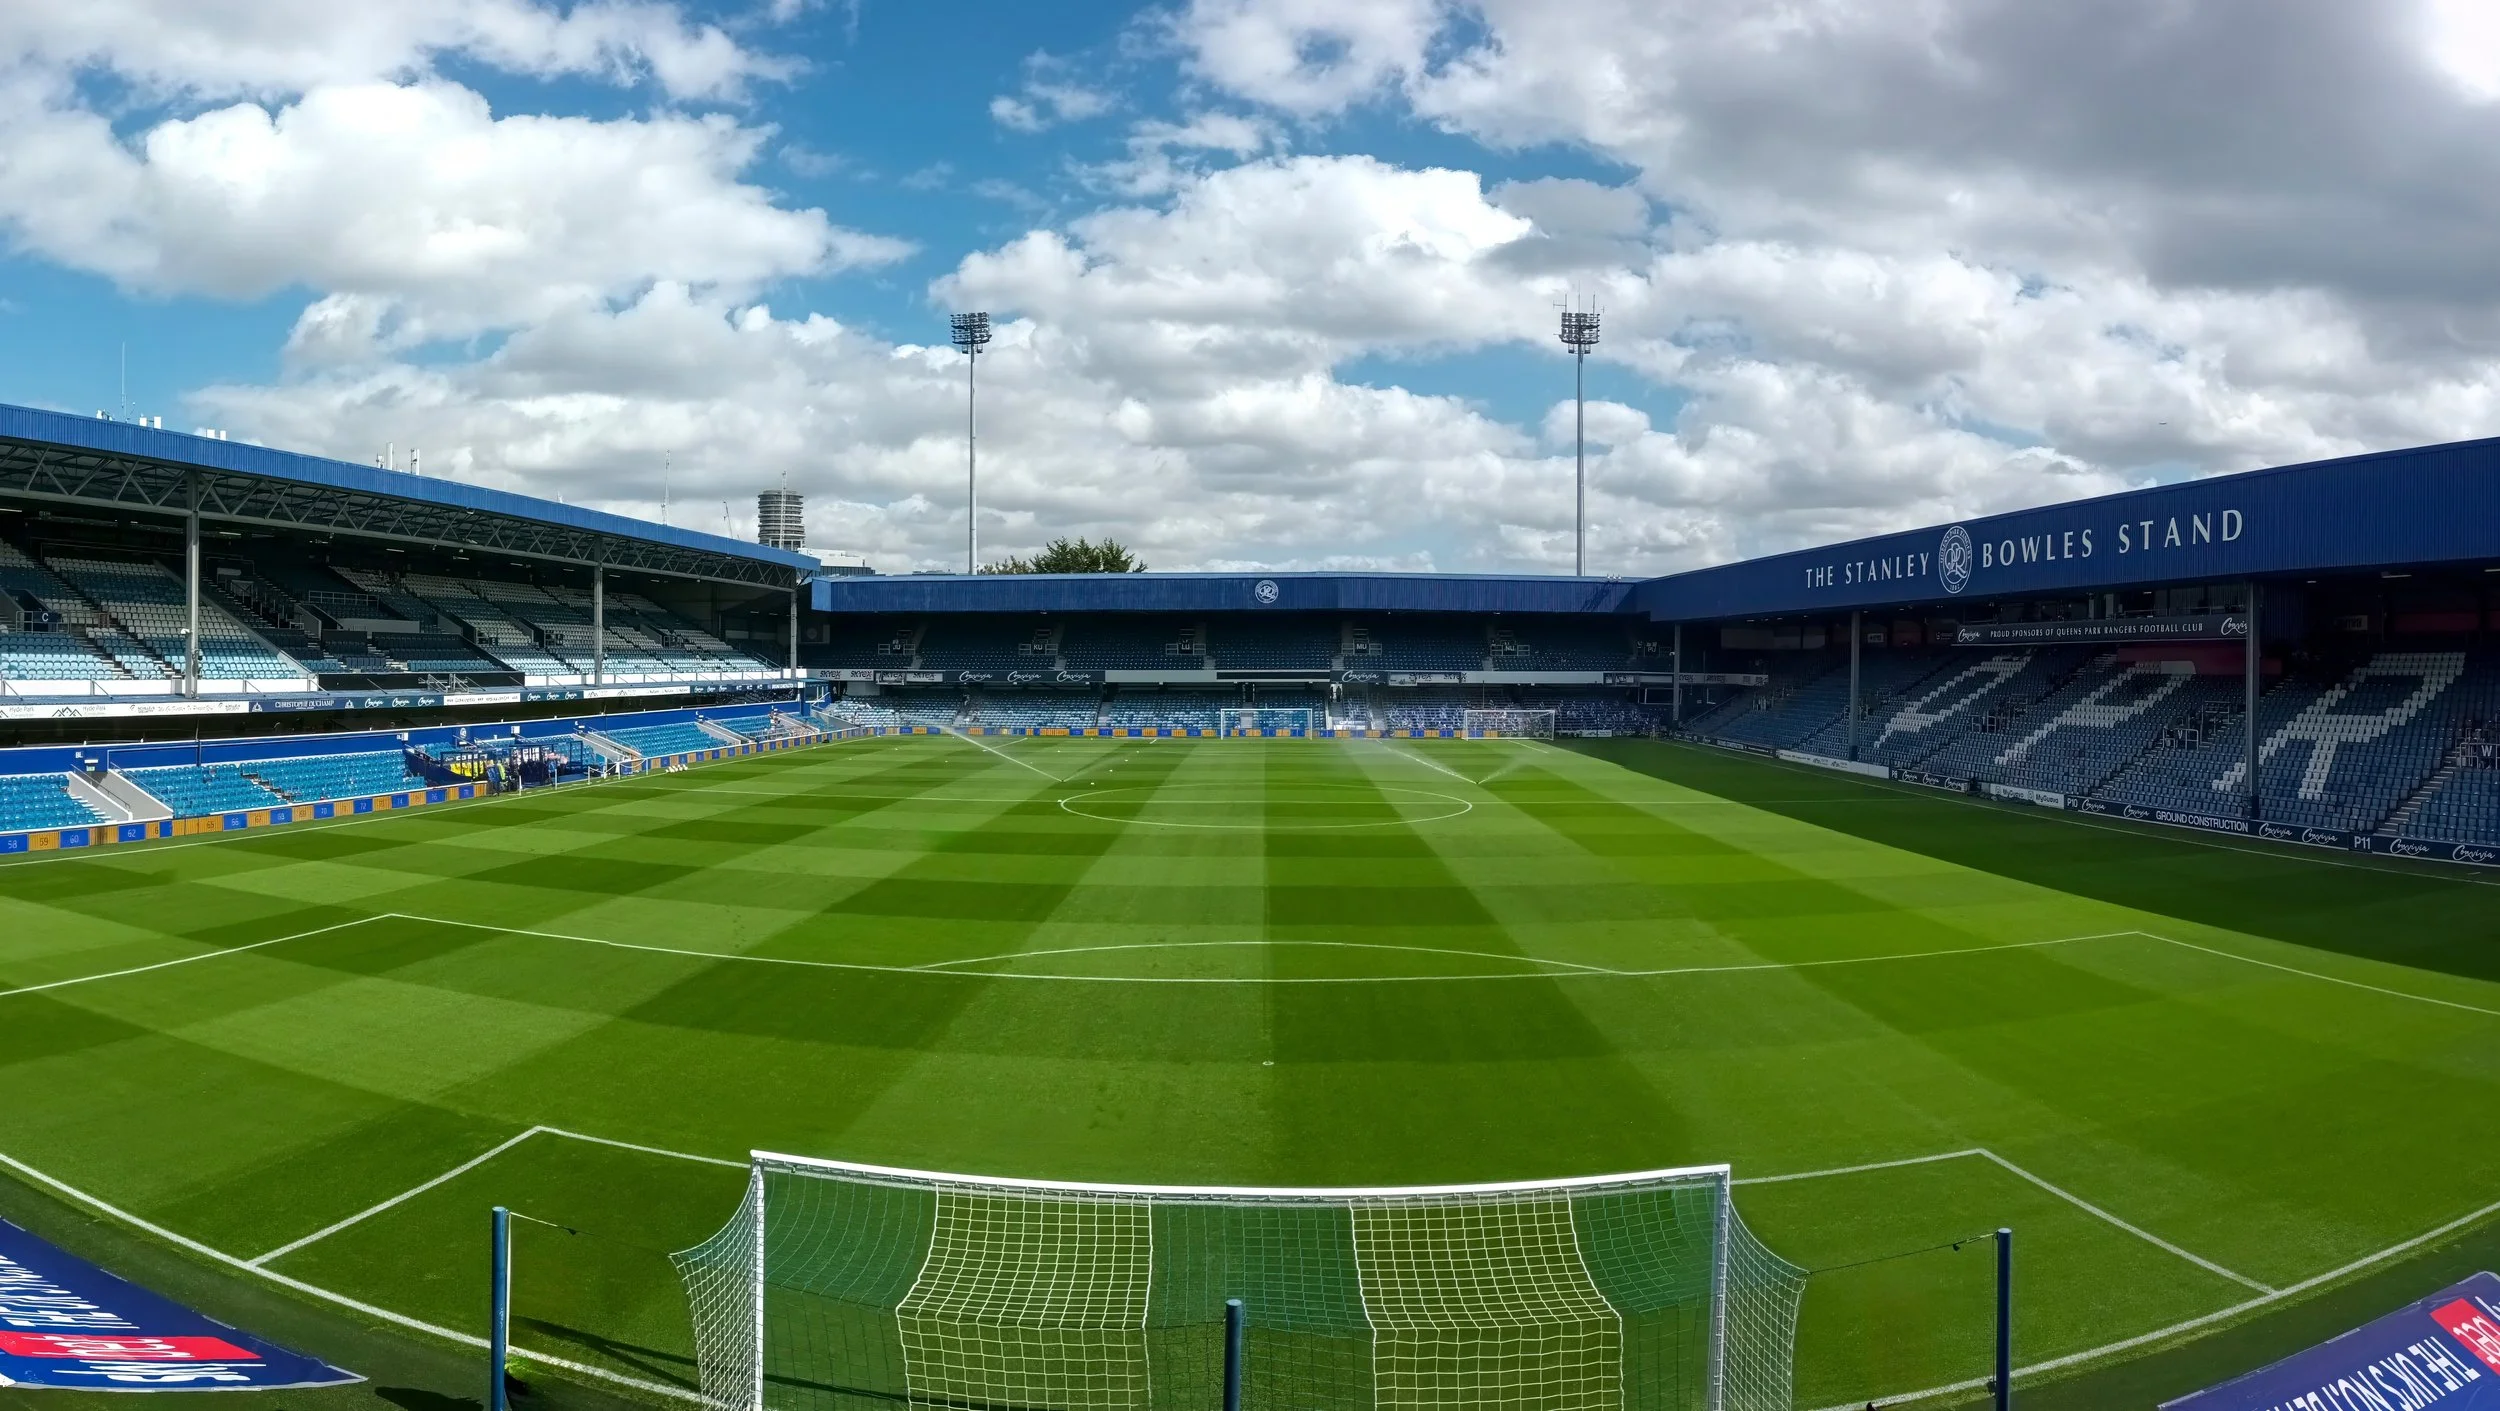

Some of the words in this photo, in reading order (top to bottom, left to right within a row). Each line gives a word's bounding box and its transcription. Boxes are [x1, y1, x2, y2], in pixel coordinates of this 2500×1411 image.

[1982, 529, 2093, 568] BOWLES
[2119, 509, 2243, 554] STAND
[1806, 565, 1834, 588] THE
[1845, 552, 1930, 584] STANLEY
[1990, 630, 2010, 638] PROUD
[2012, 629, 2043, 638] SPONSORS
[2045, 628, 2054, 636] OF
[2056, 627, 2082, 636] QUEENS
[2085, 626, 2101, 635] PARK
[2104, 625, 2137, 634] RANGERS
[2140, 623, 2179, 633] FOOTBALL
[2182, 622, 2203, 632] CLUB
[127, 827, 136, 838] 62
[2067, 797, 2078, 808] P10
[2155, 810, 2188, 824] GROUND
[2188, 815, 2250, 833] CONSTRUCTION
[2259, 822, 2293, 838] Convivia
[2302, 827, 2339, 844] Convivia
[7, 839, 18, 849] 58
[40, 836, 49, 846] 59
[2354, 835, 2371, 850] P11
[2390, 838, 2430, 855] Convivia
[2453, 844, 2496, 862] Convivia
[2408, 1336, 2481, 1392] THE
